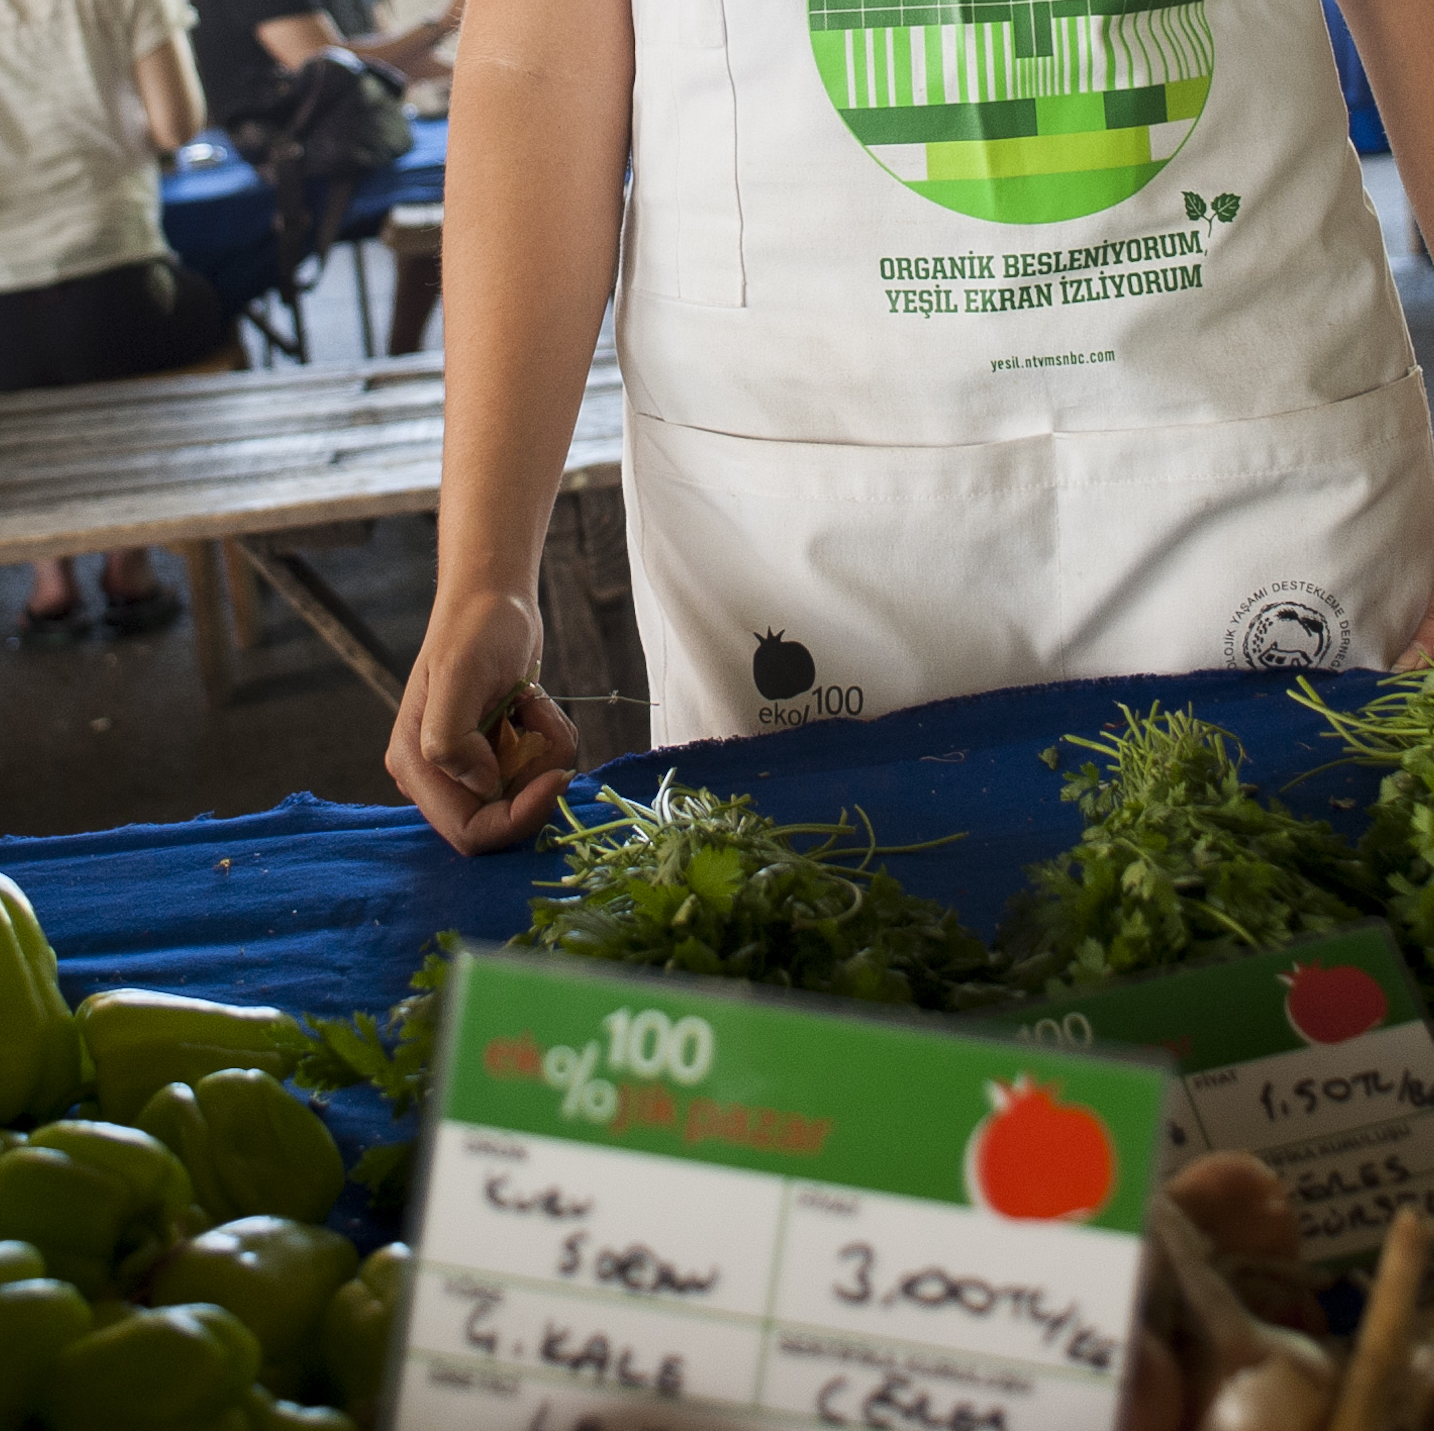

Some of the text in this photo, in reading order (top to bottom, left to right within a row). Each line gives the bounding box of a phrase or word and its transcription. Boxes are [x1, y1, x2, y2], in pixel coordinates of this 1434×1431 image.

[879, 250, 996, 281] ORGANİK
[885, 264, 1203, 319] YEŞİL EKRAN İZLİYORUM
[990, 348, 1116, 373] yesil.ntvmsnbc.com
[1230, 587, 1268, 625] YAŞAMI
[1271, 580, 1345, 619] DESTEKLEME
